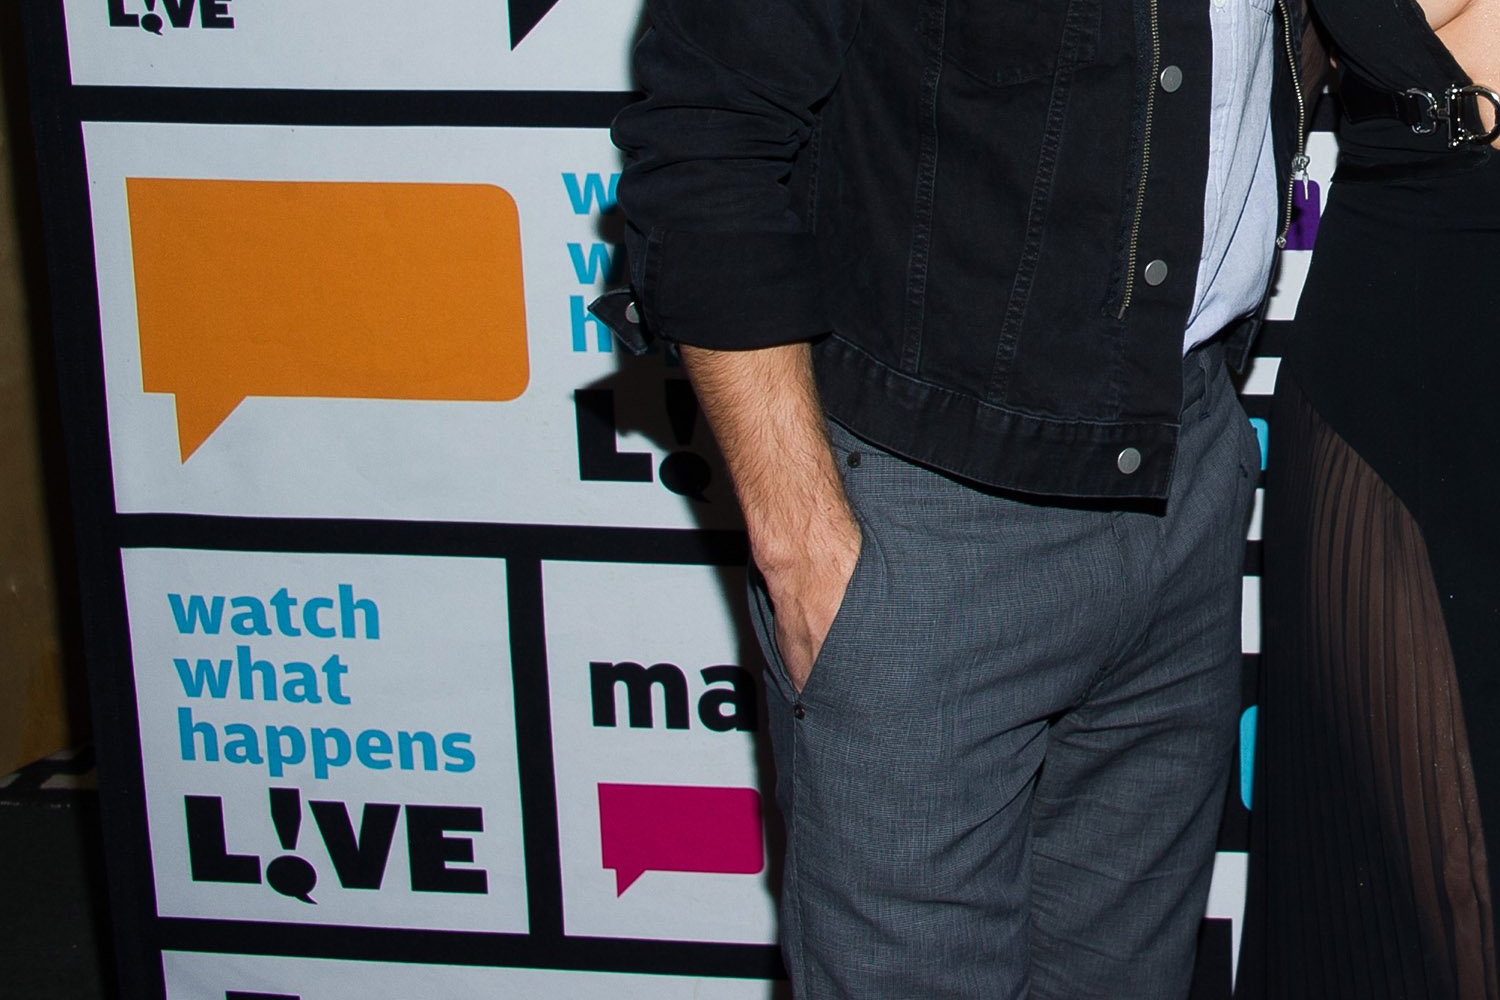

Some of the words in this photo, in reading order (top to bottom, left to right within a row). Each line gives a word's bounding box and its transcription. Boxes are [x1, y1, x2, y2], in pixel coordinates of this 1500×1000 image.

[166, 583, 381, 642] watch
[171, 644, 352, 705] what
[175, 706, 477, 781] happens
